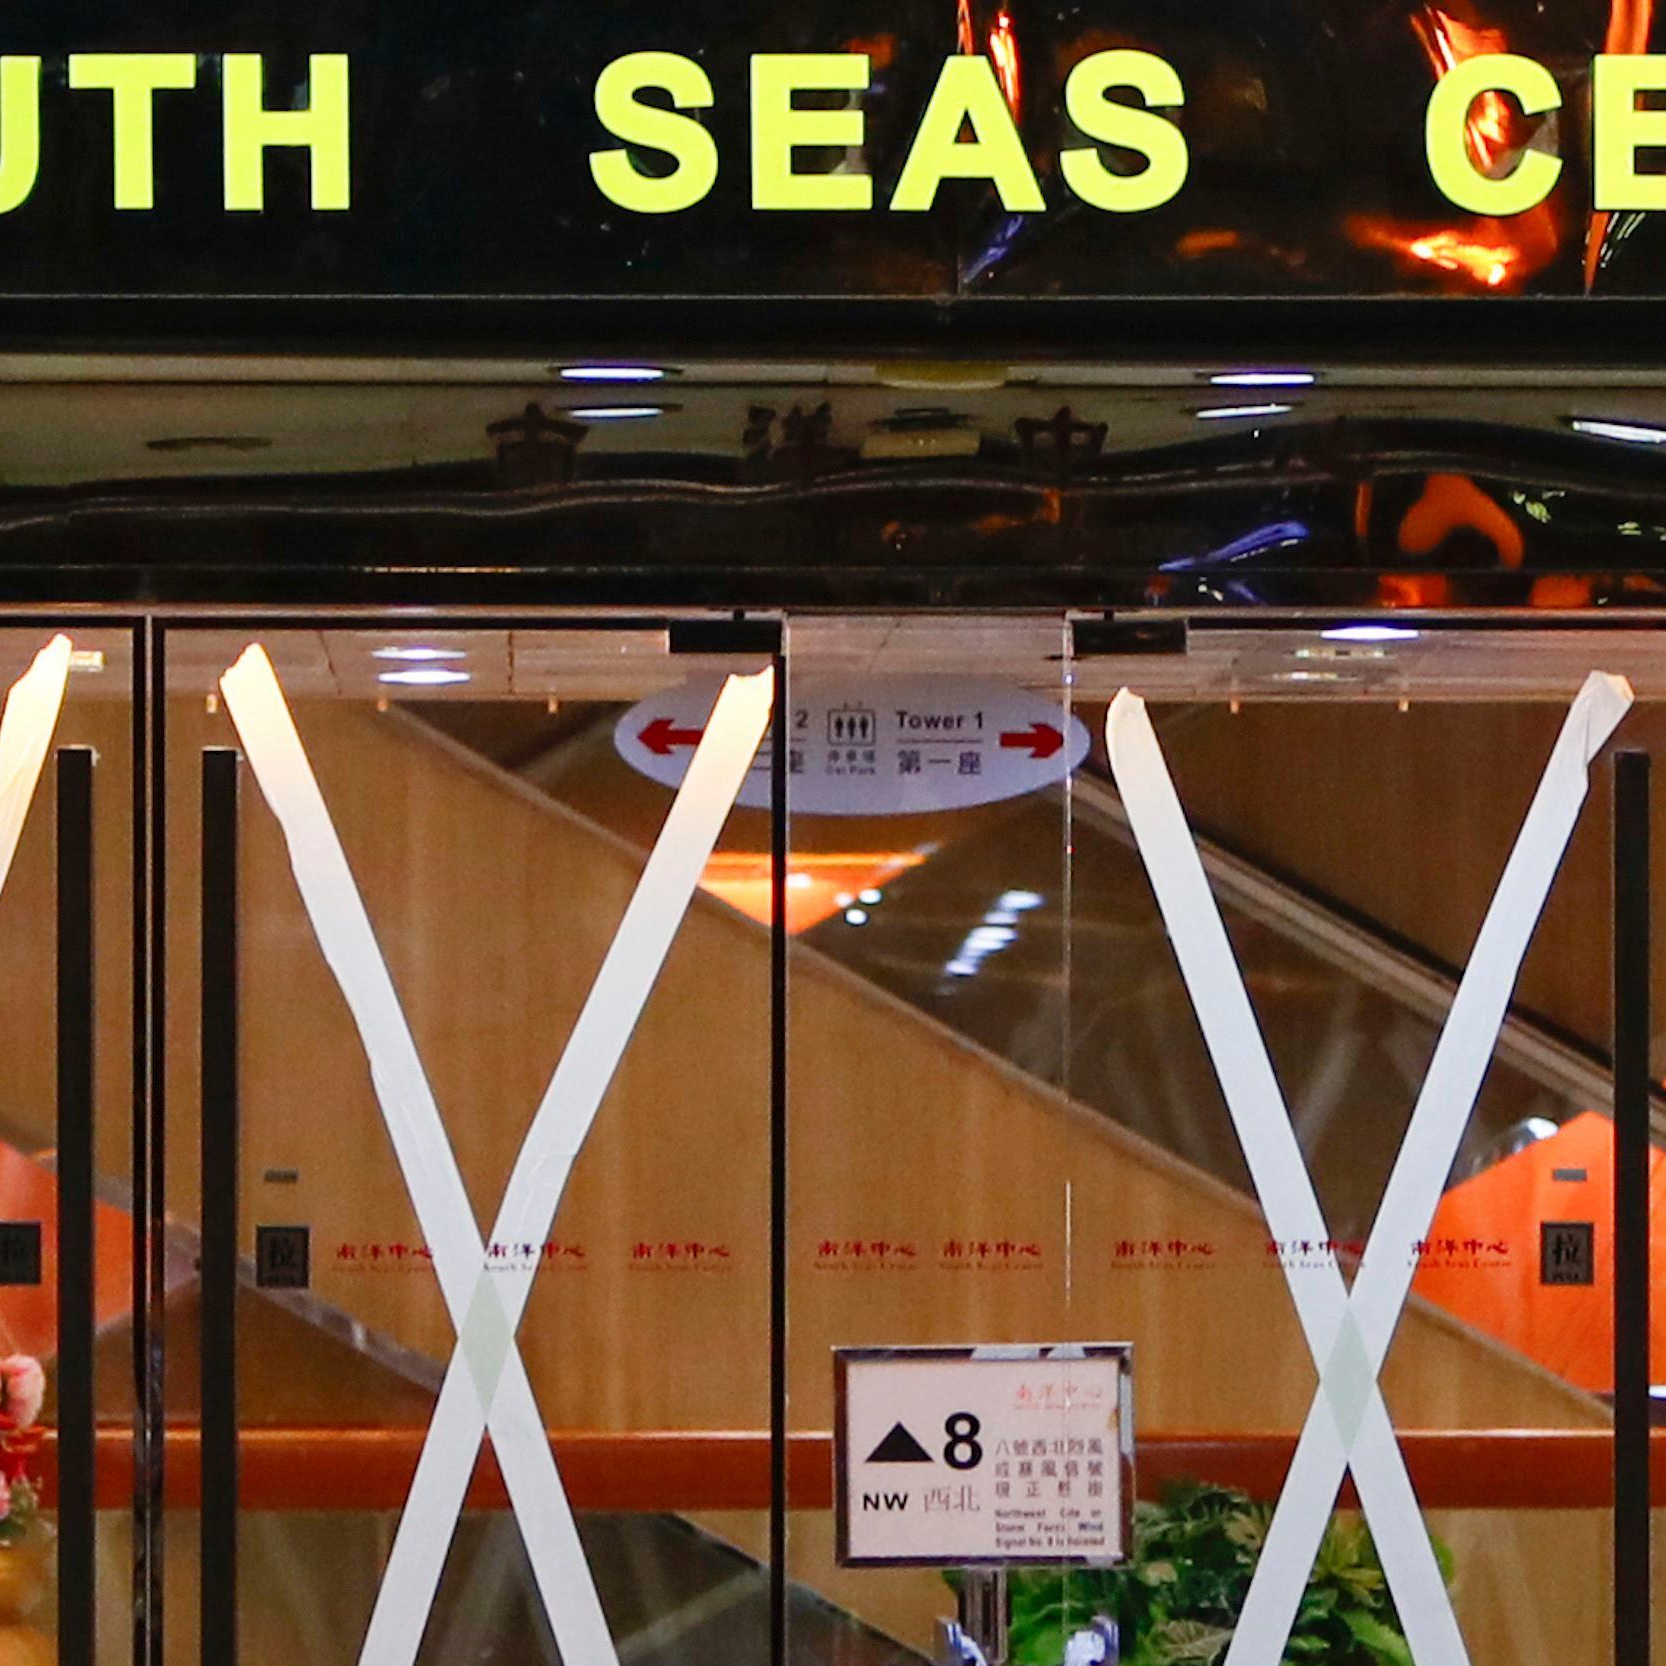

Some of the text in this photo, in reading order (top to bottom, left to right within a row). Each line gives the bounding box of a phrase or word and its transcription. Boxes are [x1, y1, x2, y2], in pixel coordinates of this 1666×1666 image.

[594, 49, 1188, 213] SEAS
[896, 711, 984, 730] Tower 1
[897, 750, 982, 776] 第一座
[943, 1411, 983, 1470] 8
[862, 1492, 909, 1512] NW
[922, 1484, 981, 1515] 西北
